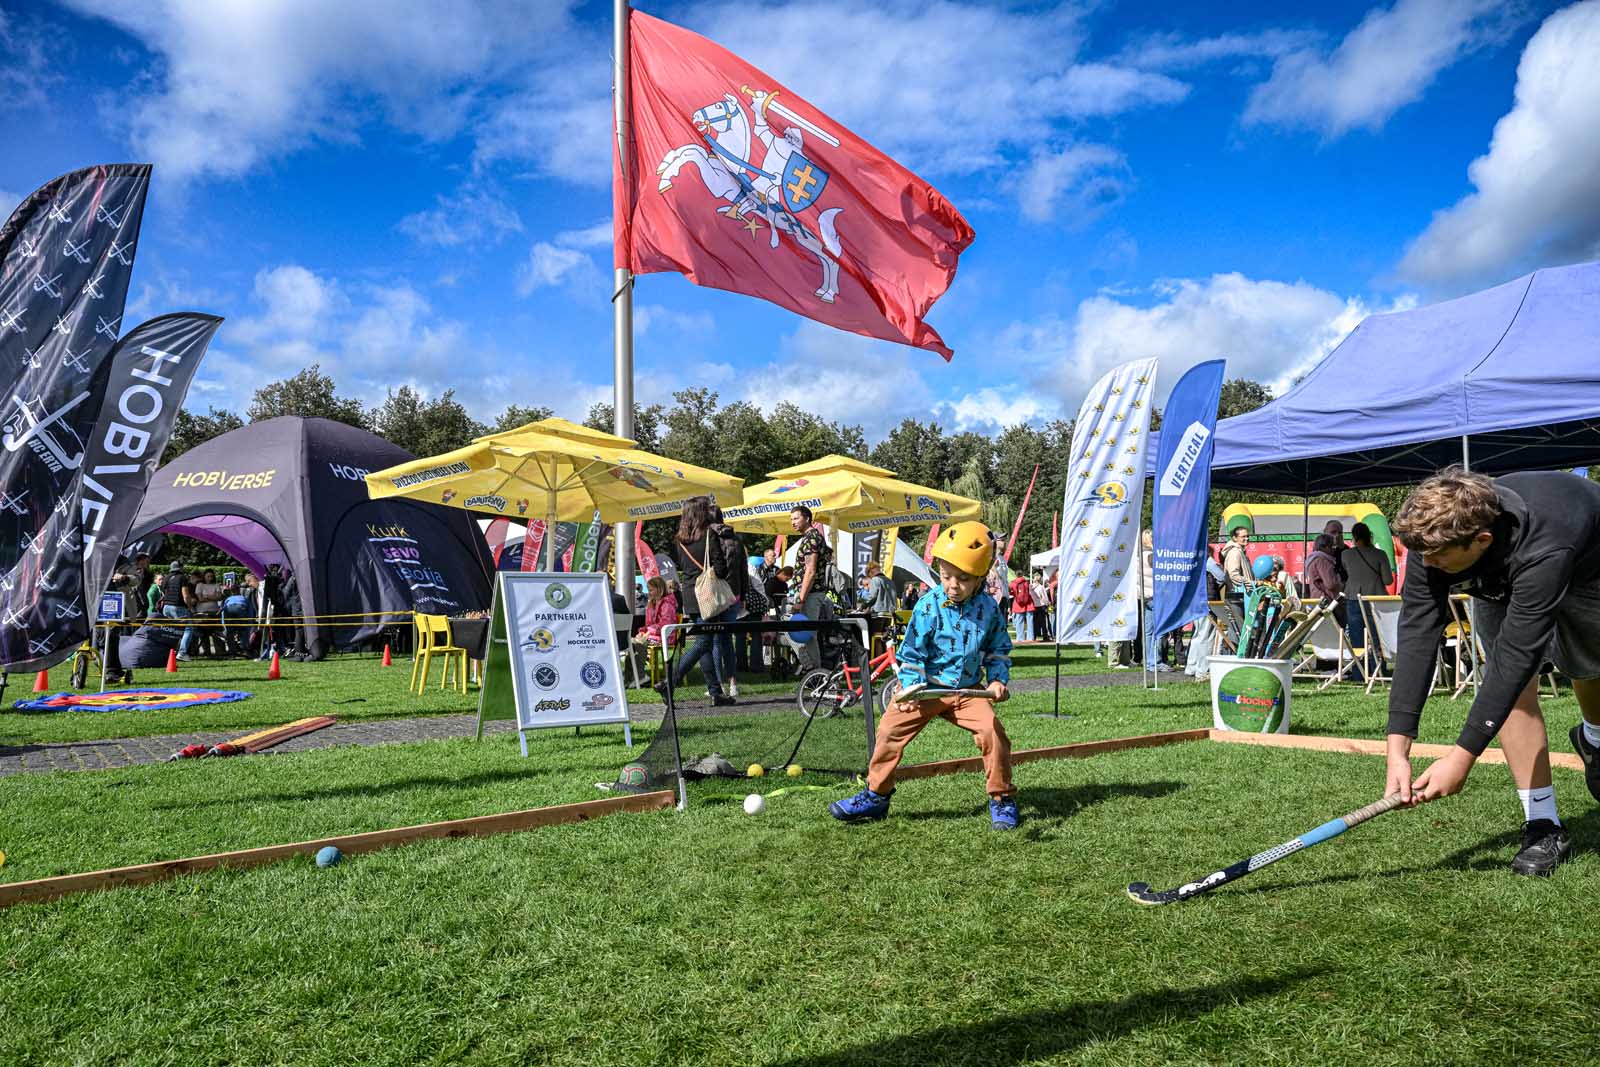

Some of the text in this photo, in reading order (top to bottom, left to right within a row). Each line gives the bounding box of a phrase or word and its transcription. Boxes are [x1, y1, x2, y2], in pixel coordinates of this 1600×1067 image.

[1171, 433, 1204, 489] VERTICAL
[172, 468, 276, 490] HOBVERSE
[366, 523, 411, 538] Kurk
[383, 547, 420, 559] savo
[1156, 549, 1194, 559] Vilniaus
[1154, 574, 1191, 582] centras
[535, 613, 587, 621] PARTNERIAI
